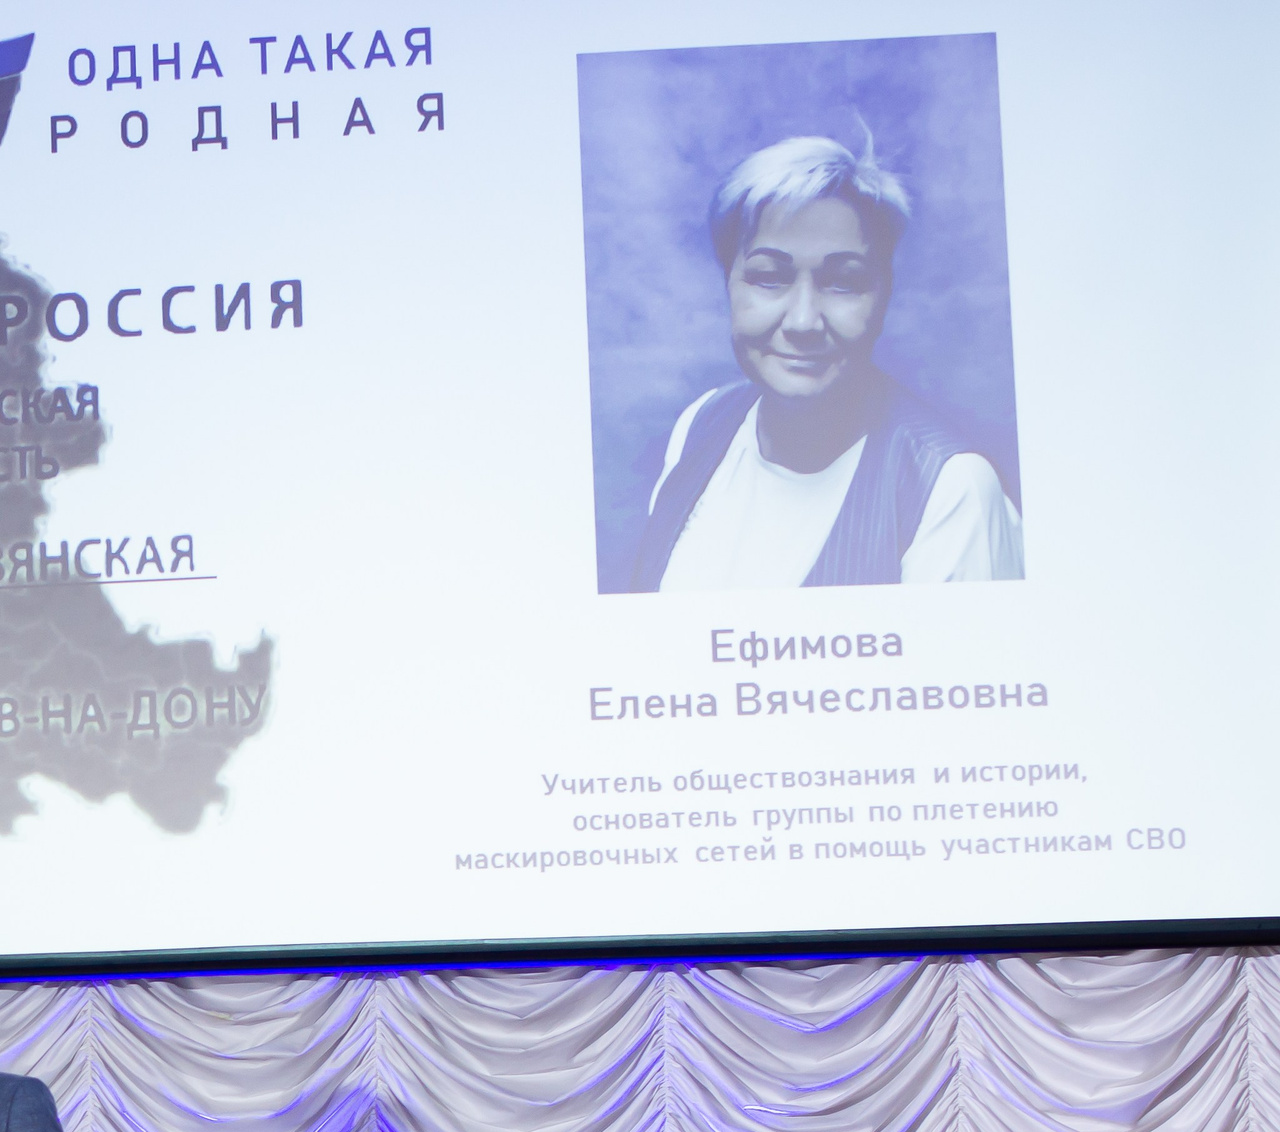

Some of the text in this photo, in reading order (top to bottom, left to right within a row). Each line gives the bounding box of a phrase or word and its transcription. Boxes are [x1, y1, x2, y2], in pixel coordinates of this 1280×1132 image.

[67, 27, 433, 92] ОДНА ТАКАЯ
[50, 93, 446, 154] РОДНАЯ
[711, 629, 902, 668] Ефимова
[590, 682, 1048, 720] Елена Вячеславовна
[542, 764, 1087, 795] Учитель обществознания и истории,
[573, 801, 1058, 832] основатель группы по плетению
[455, 827, 1187, 872] маскировочных сетей в помощь участникам СВО
